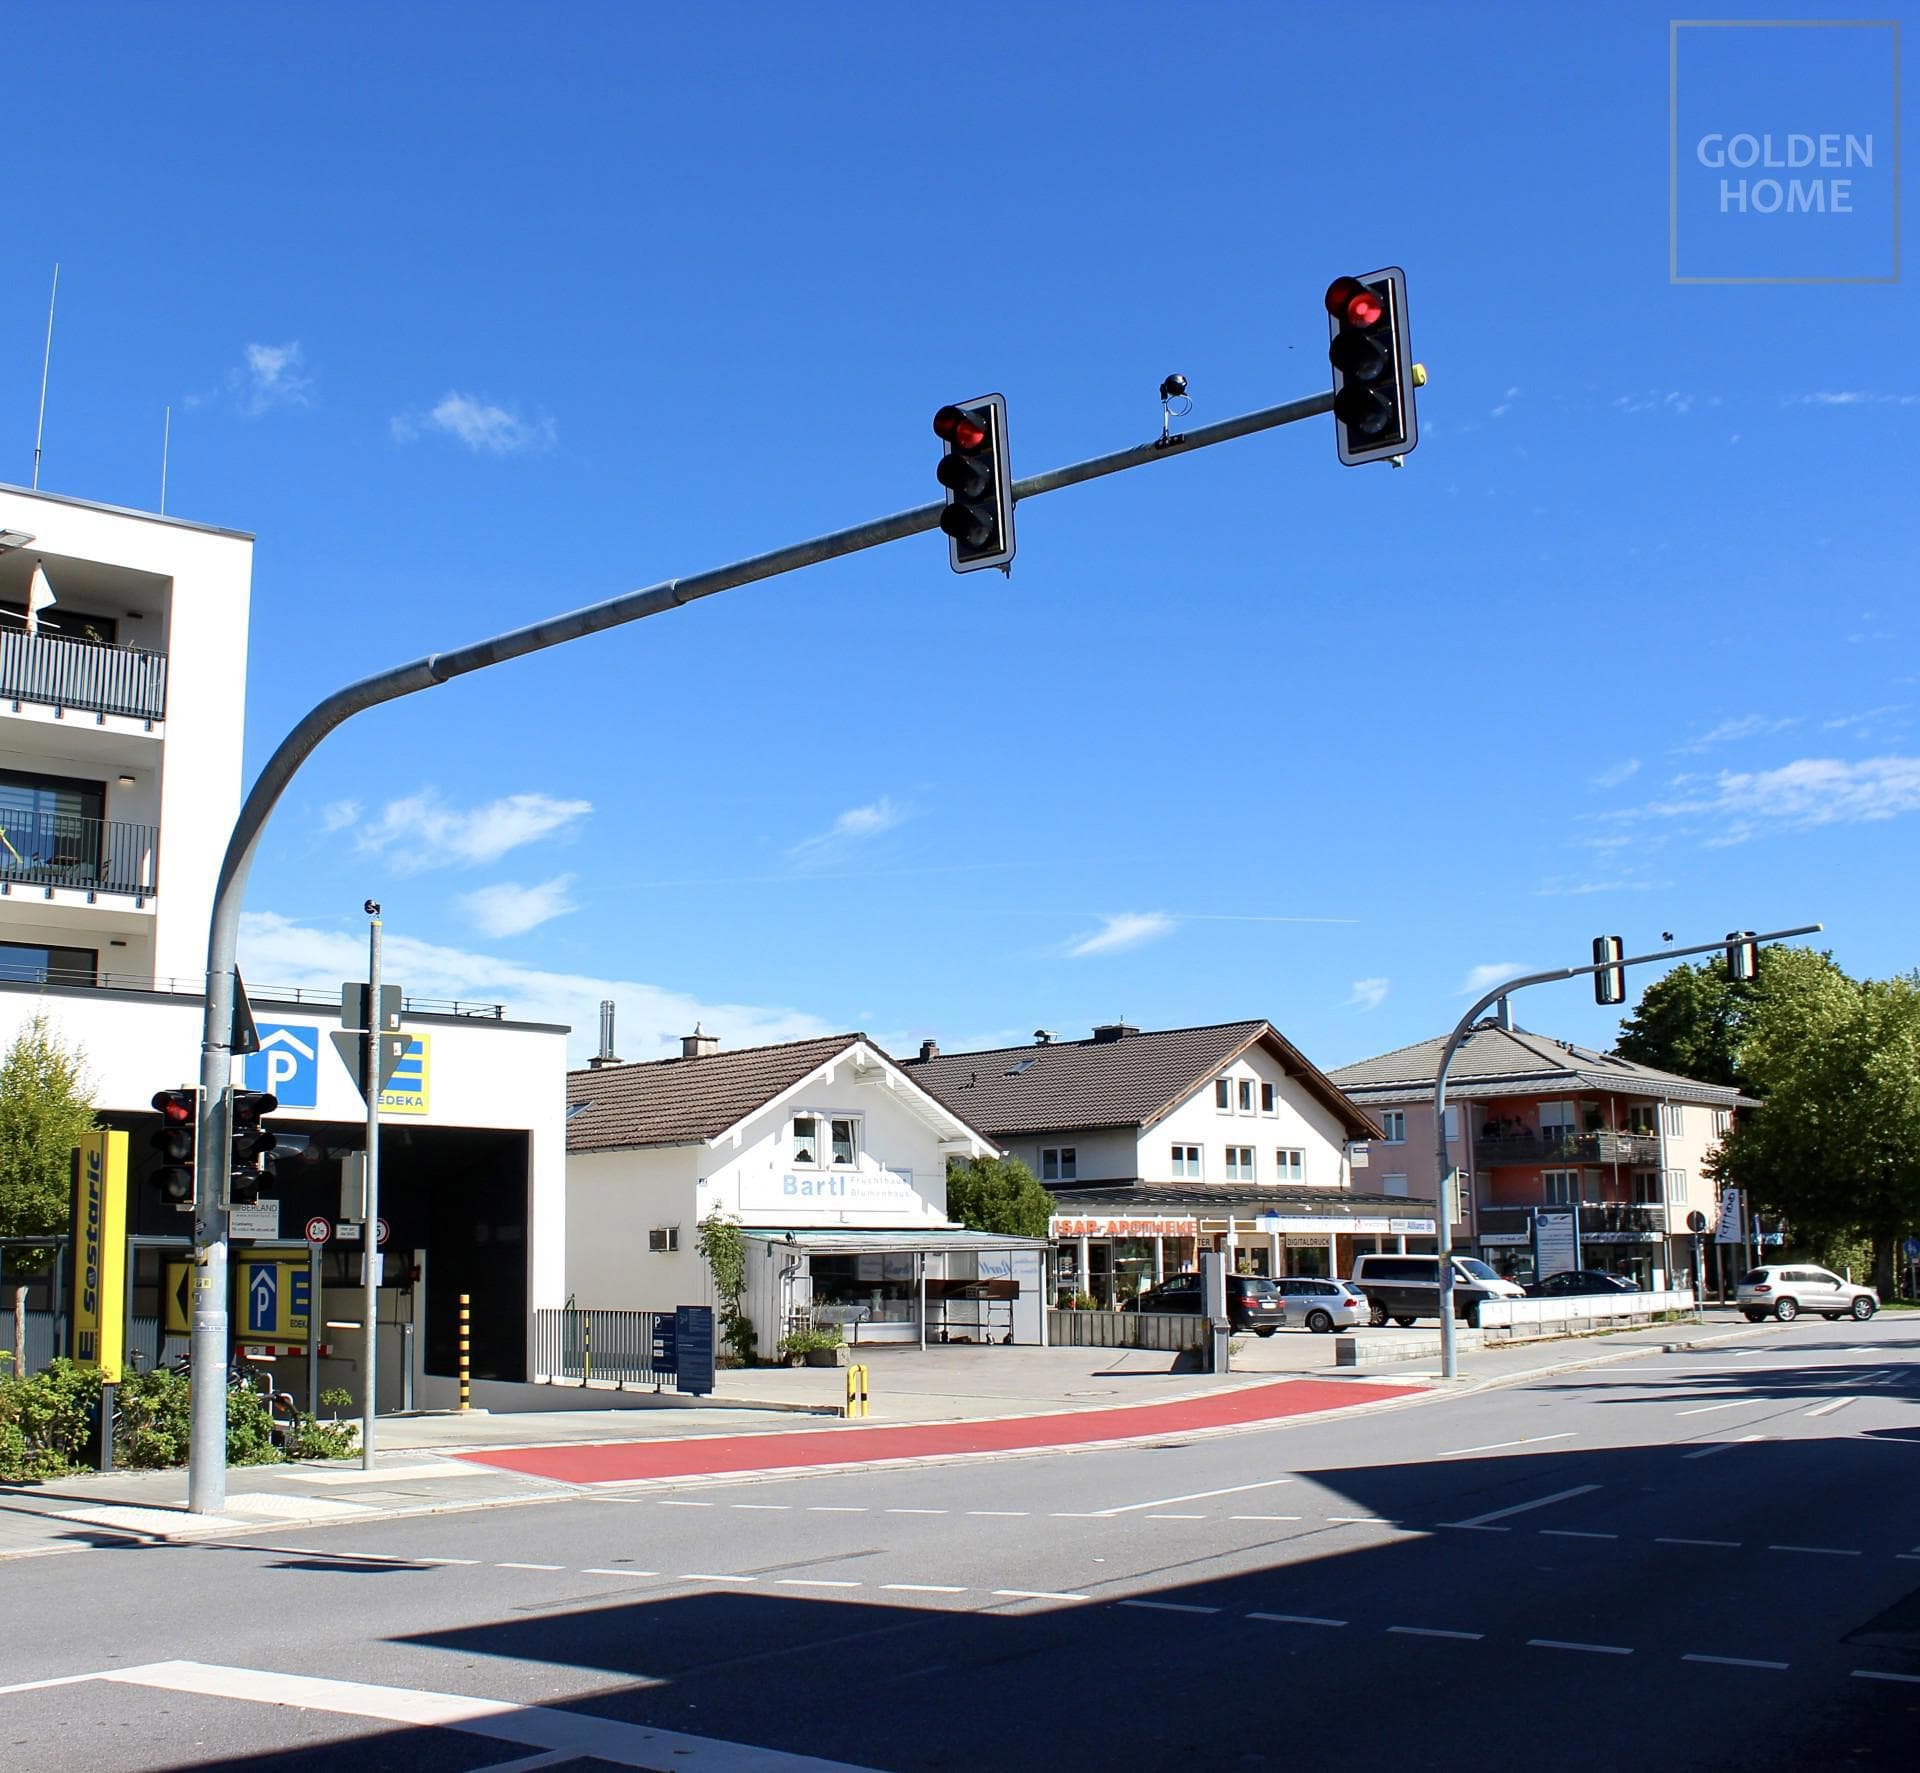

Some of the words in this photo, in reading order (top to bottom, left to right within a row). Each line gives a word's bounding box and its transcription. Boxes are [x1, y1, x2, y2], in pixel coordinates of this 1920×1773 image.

[377, 1095, 424, 1107] EDEKA
[783, 1174, 845, 1196] Bartl
[1287, 1238, 1330, 1248] DIGITALDRUCK
